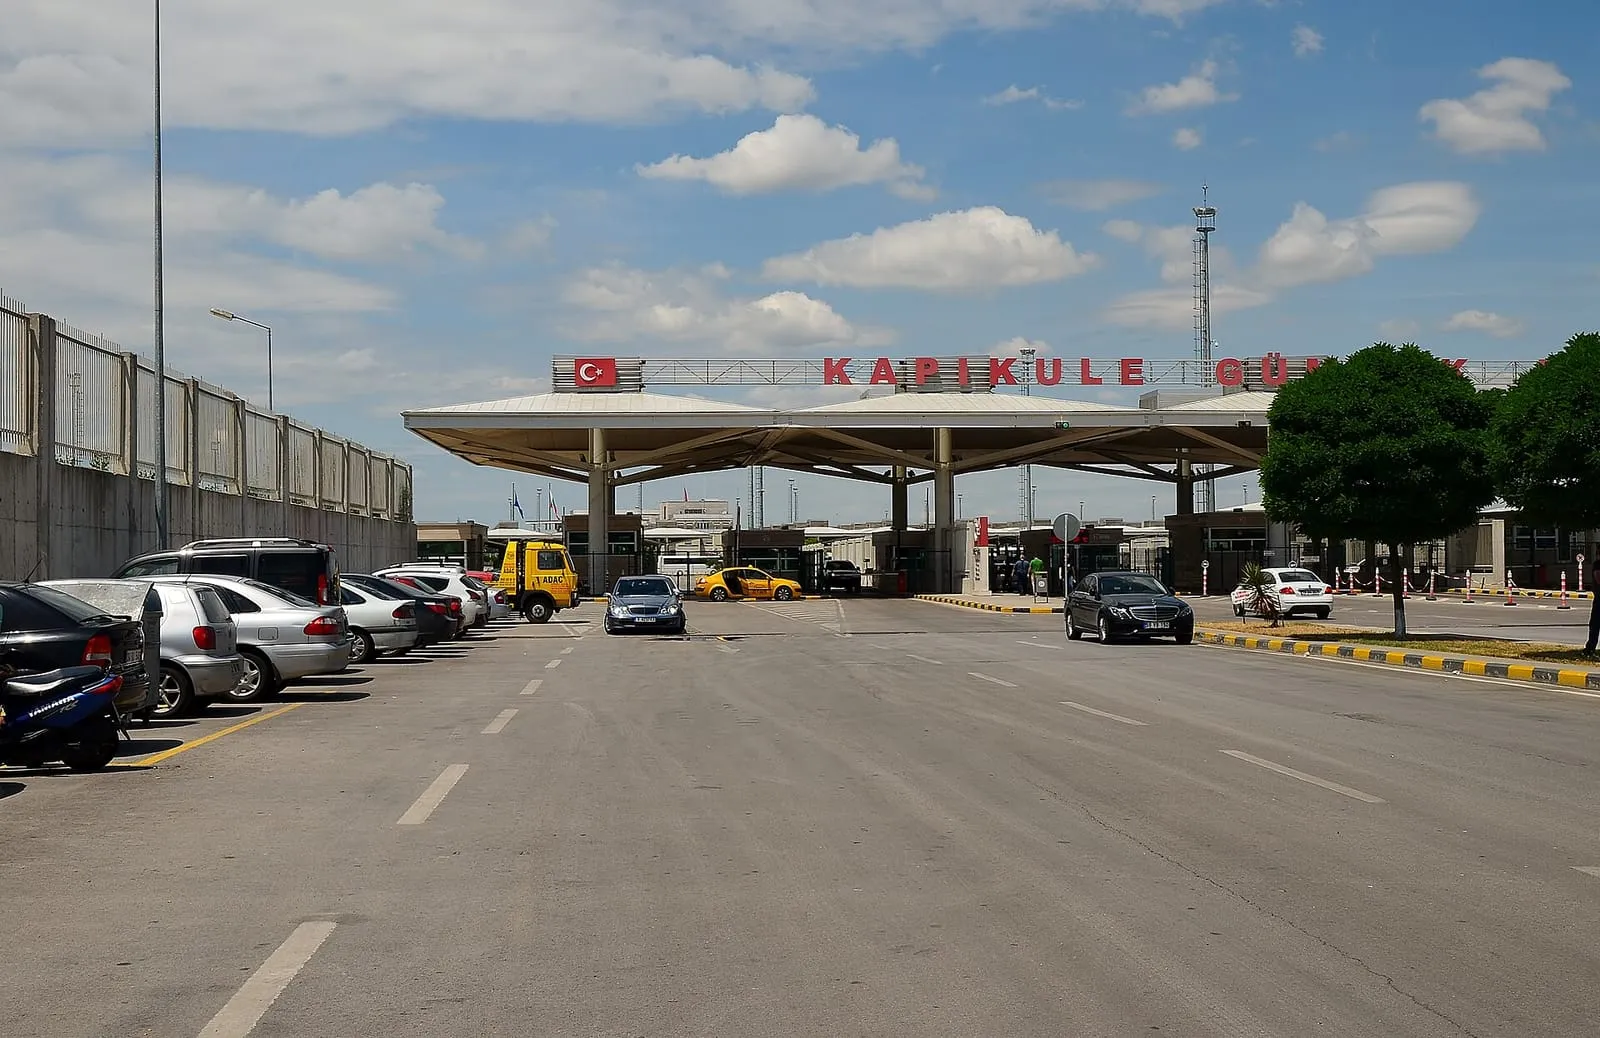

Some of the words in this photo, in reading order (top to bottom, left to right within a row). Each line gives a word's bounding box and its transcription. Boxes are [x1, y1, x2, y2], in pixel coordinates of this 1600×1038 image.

[823, 357, 1144, 385] KAPIKULE
[542, 576, 564, 584] ADAC
[28, 695, 75, 718] YAMAHA
